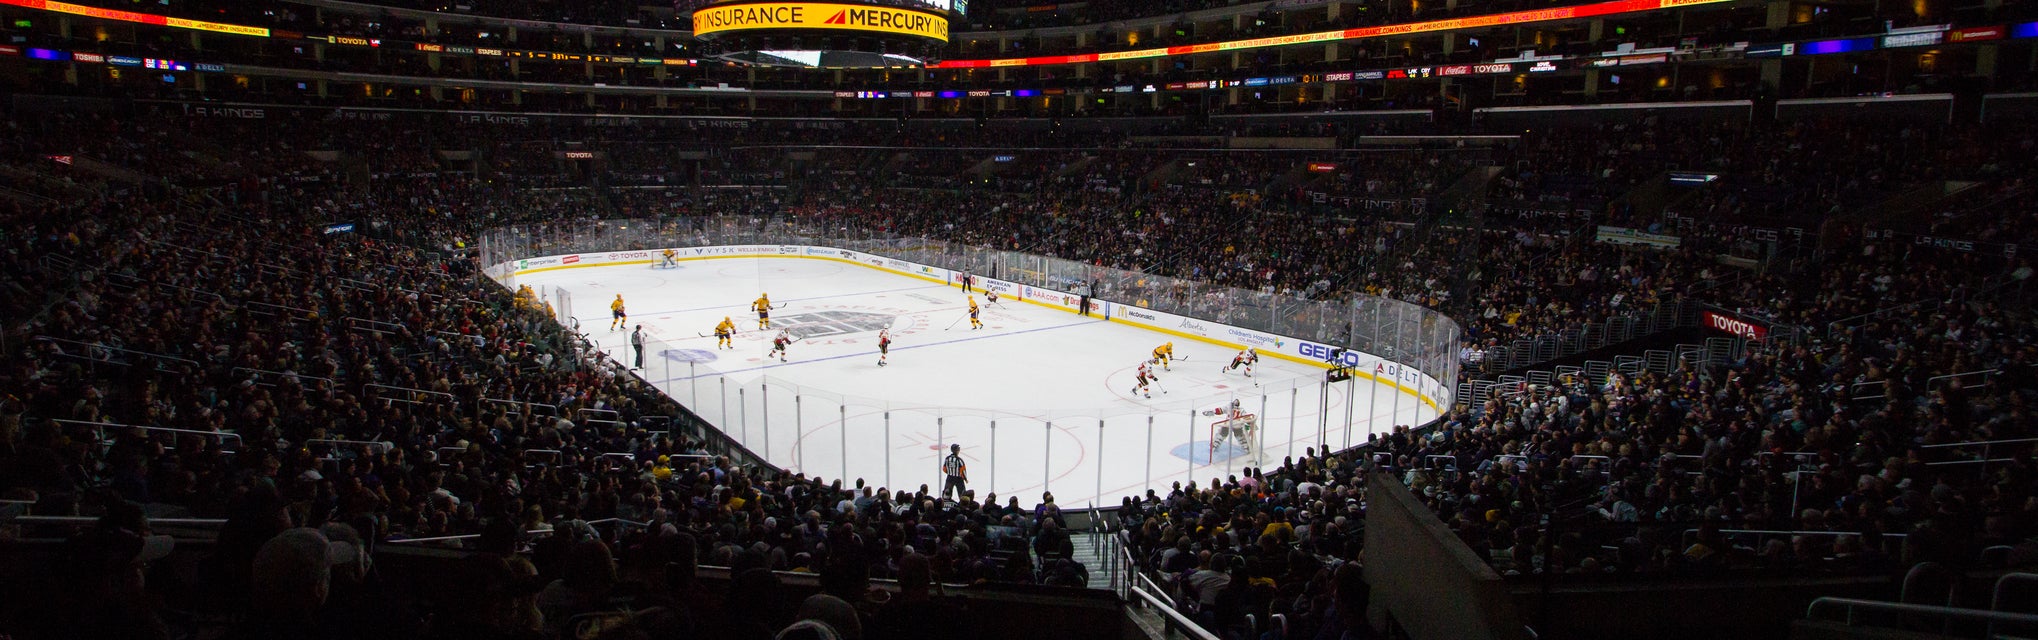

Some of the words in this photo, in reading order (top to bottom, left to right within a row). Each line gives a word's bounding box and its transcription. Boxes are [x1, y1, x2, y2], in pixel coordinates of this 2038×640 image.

[704, 7, 804, 29] INSURANCE
[849, 8, 932, 32] MERCURY
[1424, 21, 1453, 30] MERCURY
[1454, 18, 1493, 27] INSURANCE
[201, 23, 229, 32] MERCURY
[230, 26, 266, 35] INSURANCE
[337, 37, 368, 46] TOYOTA
[74, 53, 105, 62] TOSHIBA
[477, 48, 502, 56] STAPLES
[1444, 66, 1467, 75] Coca-Cola
[1473, 64, 1511, 73] TOYOTA
[1325, 73, 1351, 81] STAPLES
[212, 108, 265, 119] KINGS
[710, 120, 749, 129] KINGS
[1934, 238, 1976, 252] KINGS
[987, 279, 1011, 288] AMERICAN
[1033, 291, 1060, 303] AAA.com
[1128, 310, 1156, 321] McDonald's
[1178, 318, 1208, 332] Alberta
[1711, 314, 1757, 340] TOYOTA
[1228, 328, 1252, 340] Children's
[1253, 333, 1275, 344] Hospital
